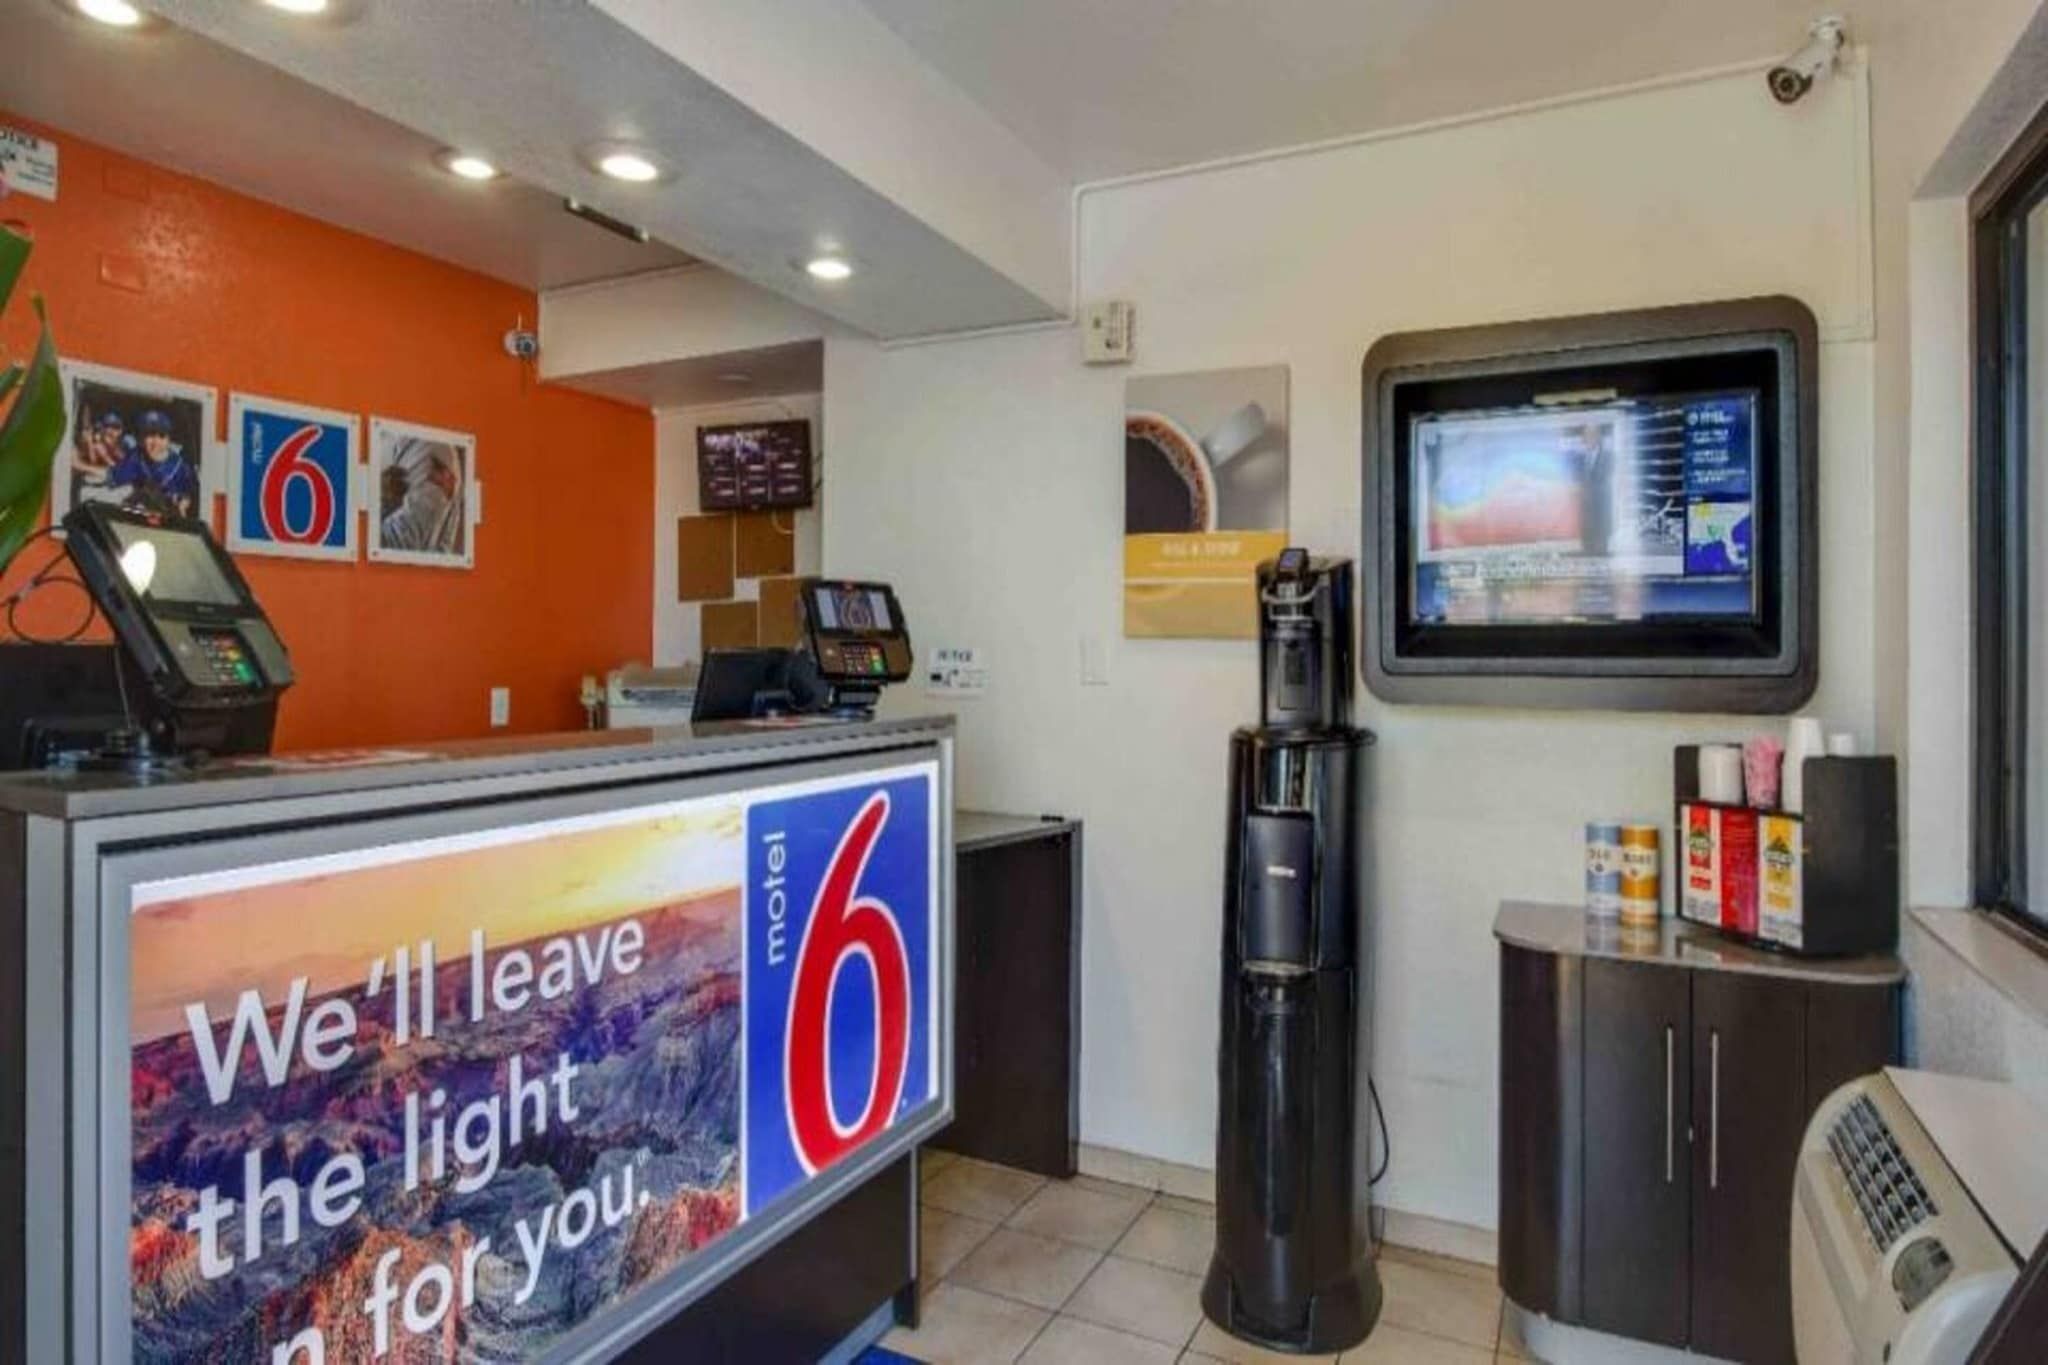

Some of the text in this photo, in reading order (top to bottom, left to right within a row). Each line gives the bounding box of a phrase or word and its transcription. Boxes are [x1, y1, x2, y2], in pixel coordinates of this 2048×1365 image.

[260, 424, 335, 546] 6
[763, 830, 786, 966] motel
[784, 788, 912, 1177] 6
[185, 919, 645, 1106] We'll leave
[186, 1052, 580, 1280] the light
[363, 1235, 490, 1358] for
[515, 1164, 650, 1304] you.
